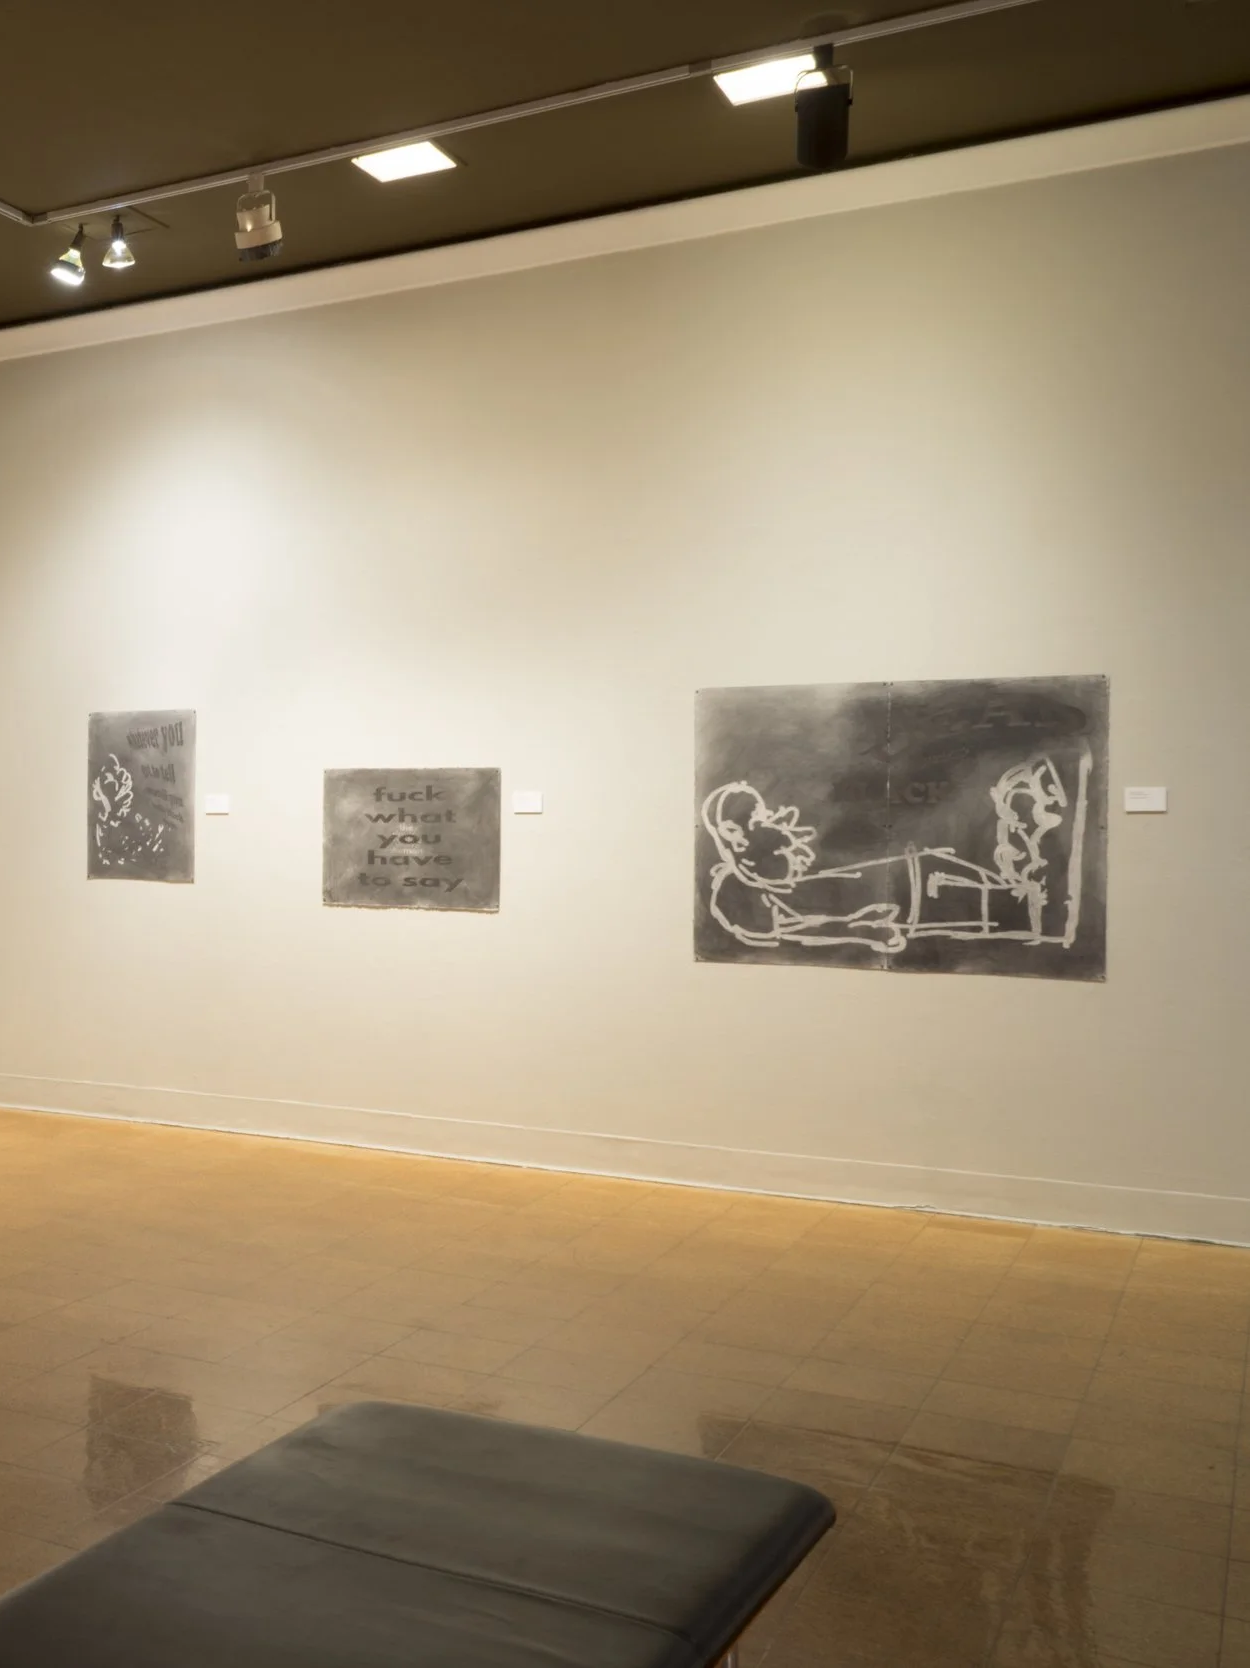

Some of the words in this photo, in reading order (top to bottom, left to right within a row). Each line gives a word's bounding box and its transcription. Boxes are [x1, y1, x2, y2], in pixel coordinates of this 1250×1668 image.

[373, 784, 447, 802] fuck
[364, 807, 456, 823] what
[376, 833, 442, 849] you
[367, 849, 453, 866] have
[357, 872, 391, 887] to
[402, 876, 464, 893] say
